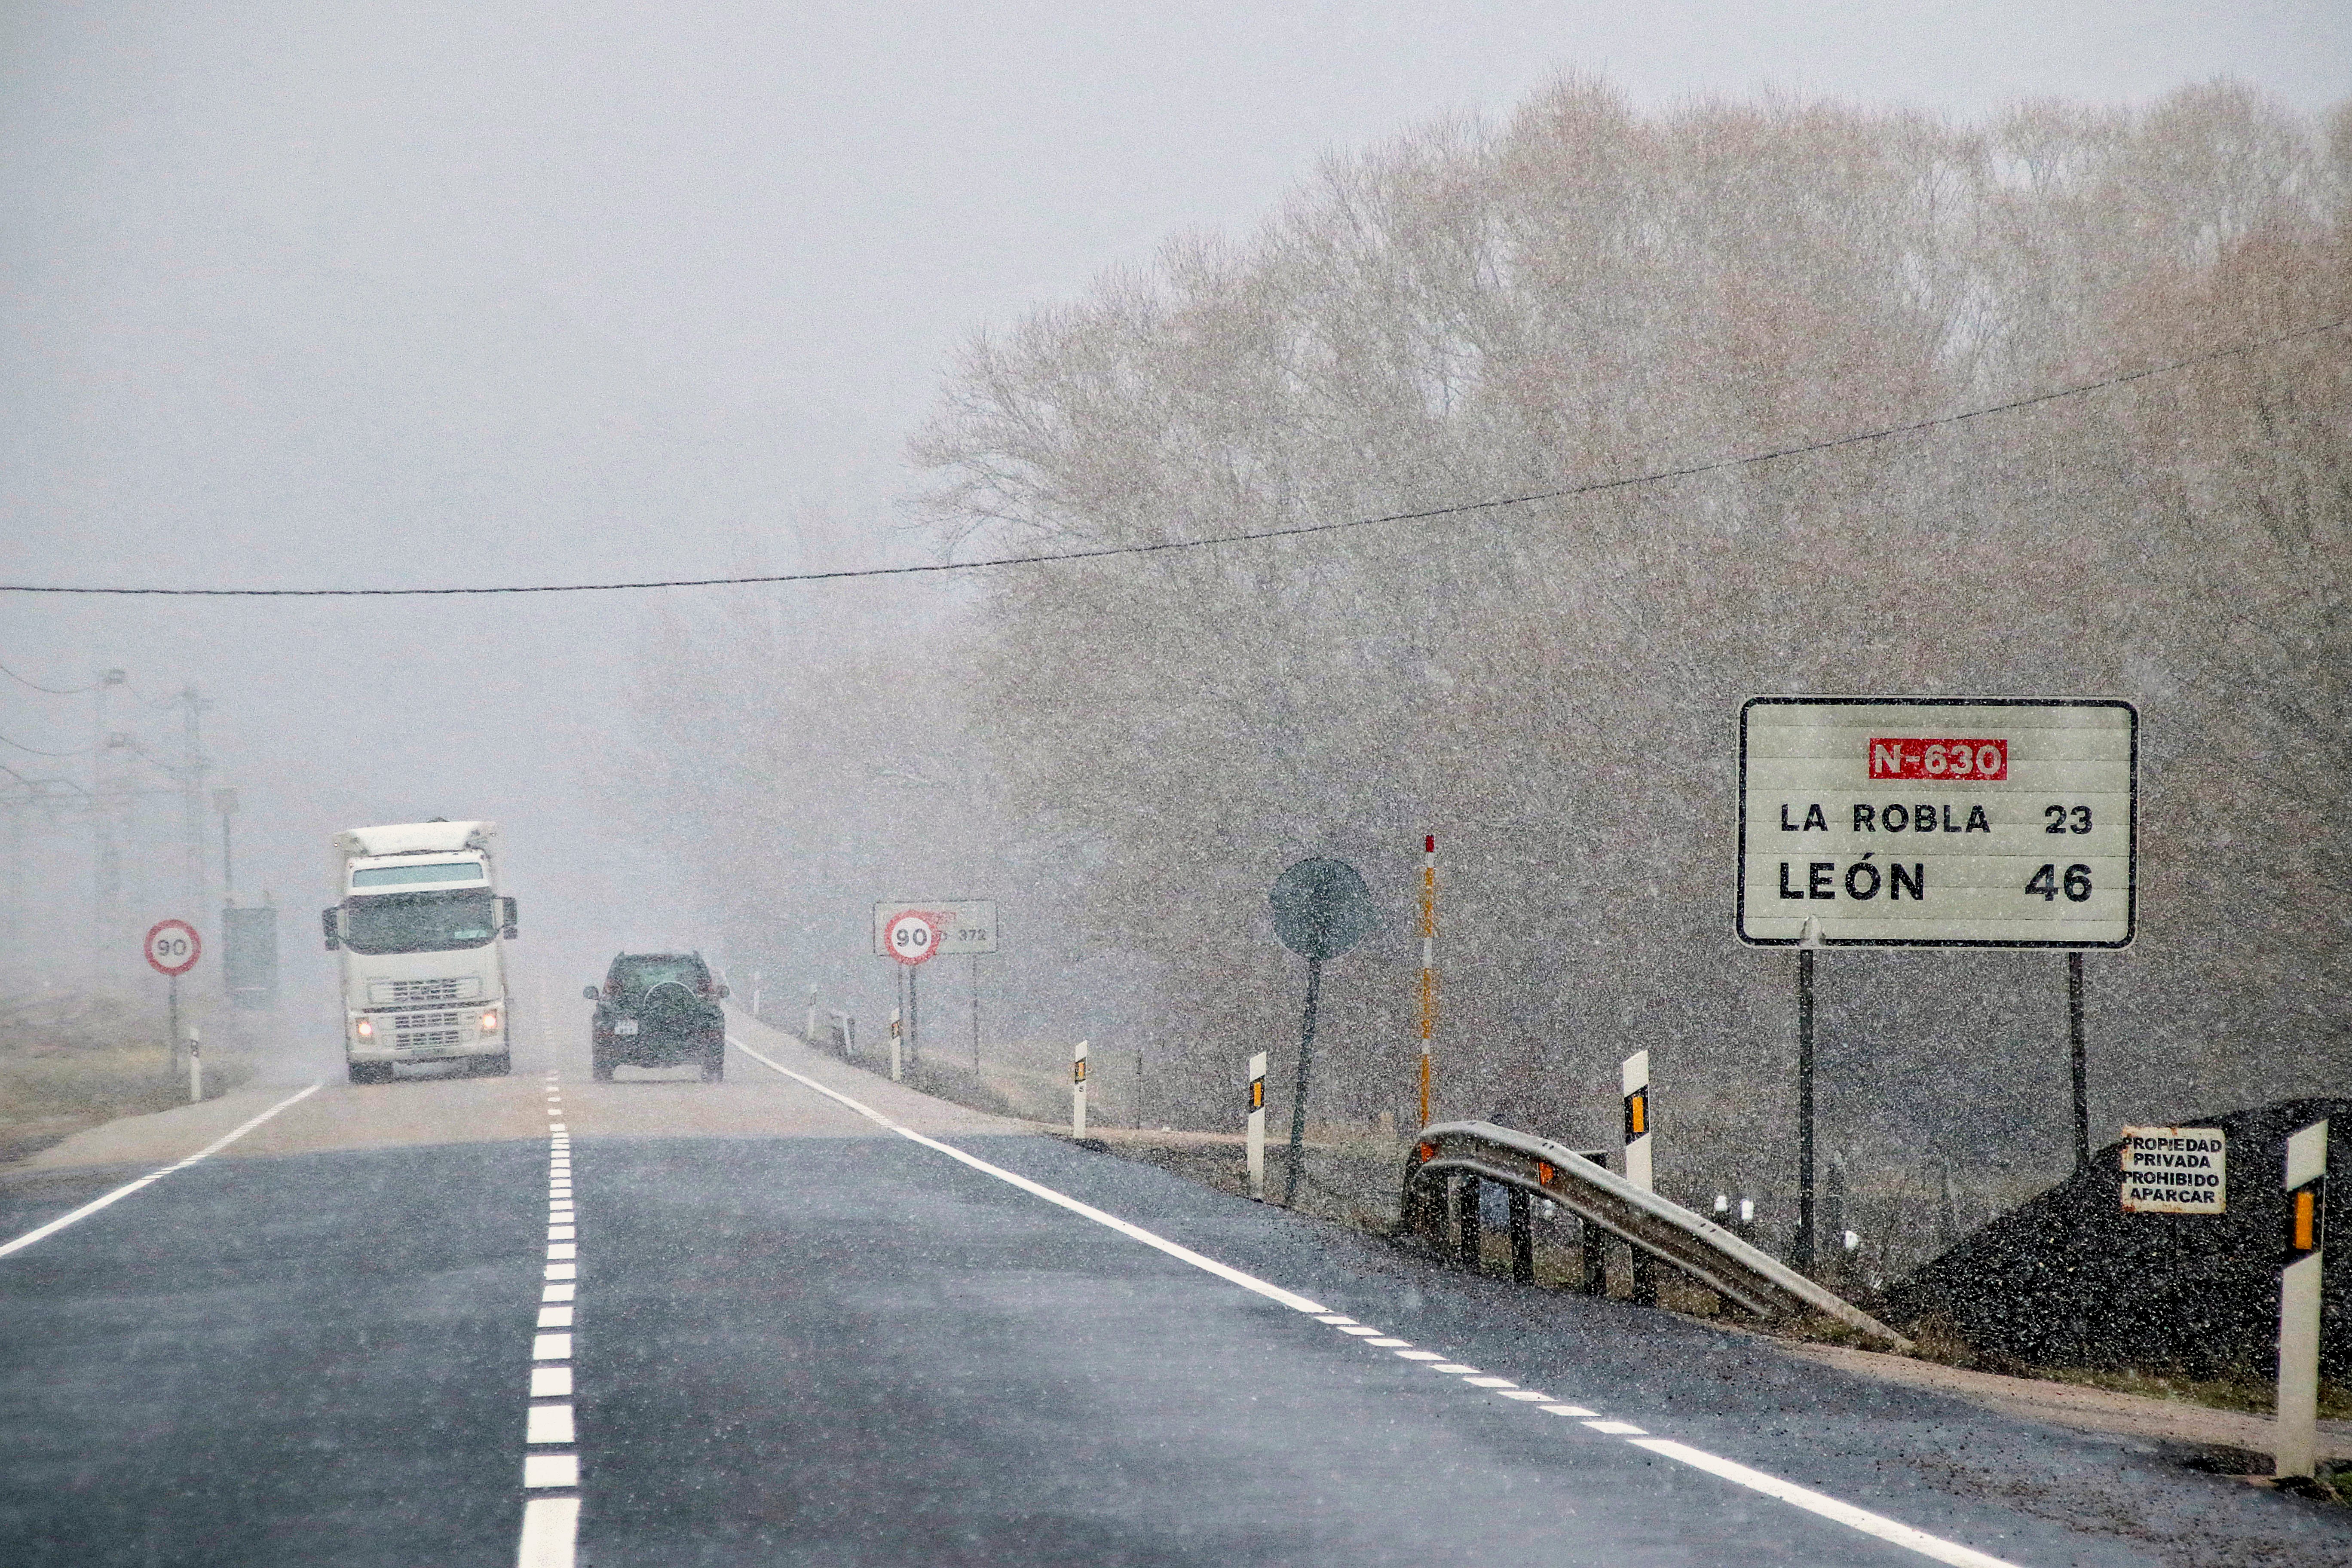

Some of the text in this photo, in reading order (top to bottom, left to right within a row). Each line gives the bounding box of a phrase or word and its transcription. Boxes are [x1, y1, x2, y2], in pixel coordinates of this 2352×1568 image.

[1875, 744, 2003, 775] N-630
[1781, 803, 2093, 834] LA ROBLA 23
[1780, 852, 2093, 902] LEÓN 46
[897, 928, 927, 946] 90
[158, 939, 186, 956] 90
[2123, 1137, 2222, 1152] PROPIEDAD
[2134, 1153, 2211, 1168] PRIVADA
[2122, 1171, 2219, 1187] PROHIBIDO
[2130, 1188, 2215, 1203] APARCAR
